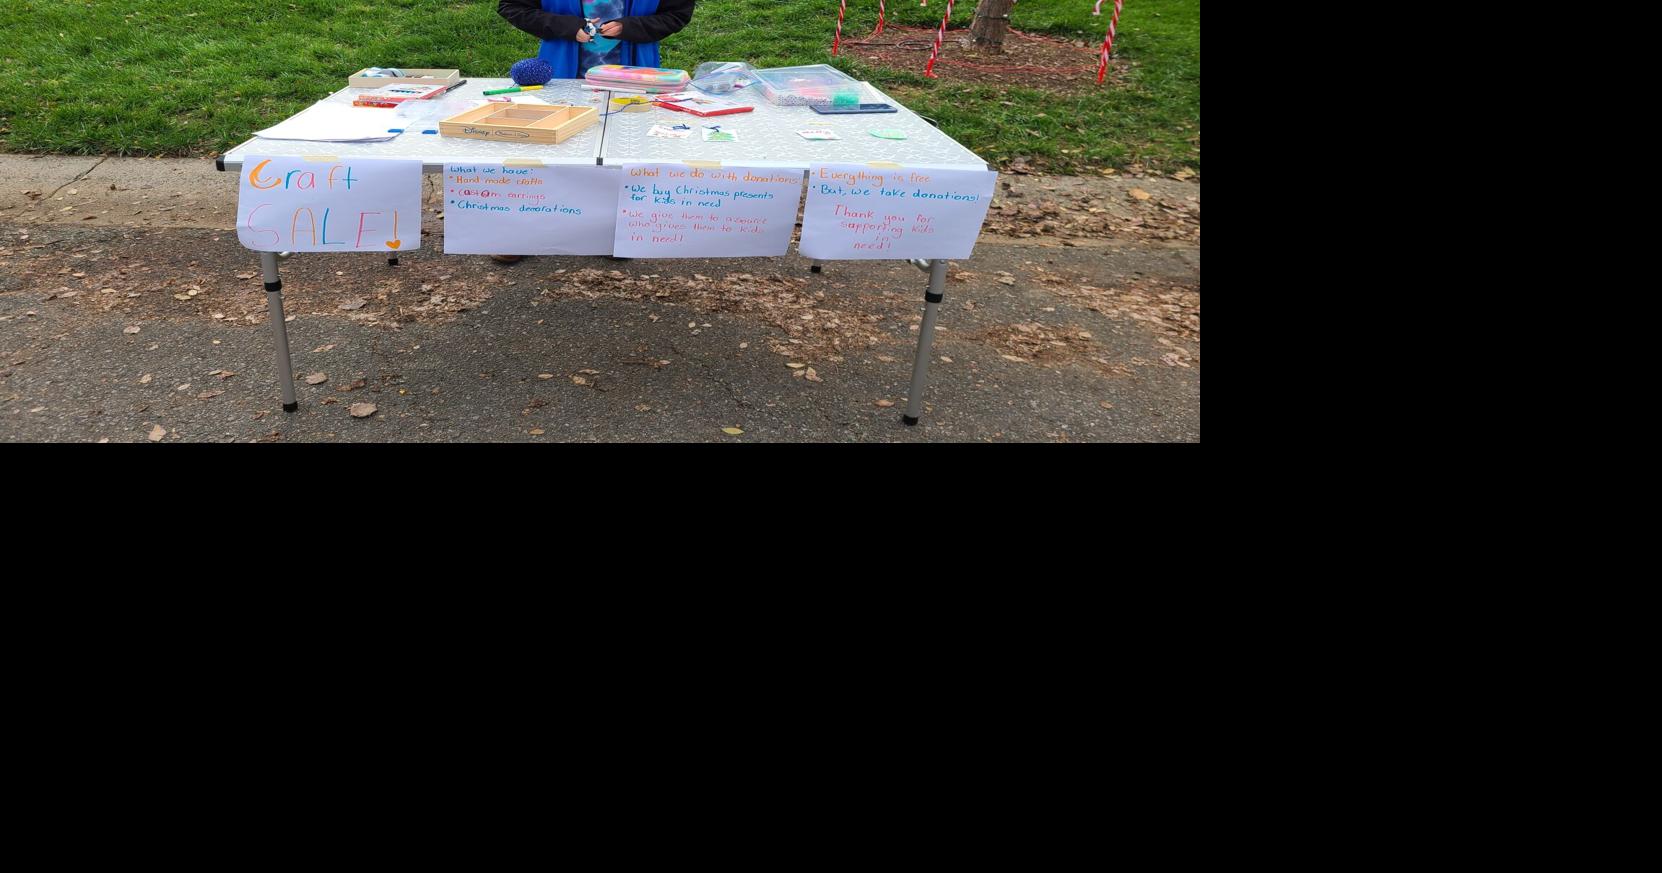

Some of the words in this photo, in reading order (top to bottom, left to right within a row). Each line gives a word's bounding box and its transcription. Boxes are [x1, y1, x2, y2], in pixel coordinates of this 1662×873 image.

[249, 159, 358, 190] Craft
[456, 176, 480, 184] Hand
[630, 168, 660, 178] What
[669, 169, 686, 178] we
[690, 168, 704, 179] do
[712, 171, 737, 182] with
[743, 170, 798, 185] donations
[820, 168, 884, 187] Everything
[892, 171, 904, 182] is
[910, 172, 932, 183] free
[631, 185, 646, 193] We
[652, 184, 671, 197] buy
[676, 185, 730, 197] Christmas
[733, 190, 774, 200] presents
[820, 185, 846, 196] But,
[851, 187, 870, 195] we
[880, 187, 906, 198] take
[913, 188, 980, 204] donations!
[457, 200, 511, 212] Christmas
[630, 193, 647, 201] for
[654, 196, 676, 205] kids
[681, 198, 692, 206] in
[698, 199, 721, 208] need
[629, 210, 643, 218] We
[650, 212, 673, 223] give
[681, 212, 704, 220] them
[709, 214, 719, 222] to
[834, 204, 874, 218] Thank
[884, 214, 905, 223] you
[916, 214, 934, 222] for
[248, 203, 401, 249] SALE!
[628, 220, 650, 228] who
[655, 220, 688, 232] gives
[693, 223, 715, 231] them
[720, 224, 732, 233] to
[740, 225, 764, 234] kids
[840, 222, 904, 239] supporting
[911, 224, 934, 234] kids
[631, 232, 643, 241] in
[652, 234, 683, 243] need!
[853, 241, 892, 249] need!
[875, 233, 889, 242] in
